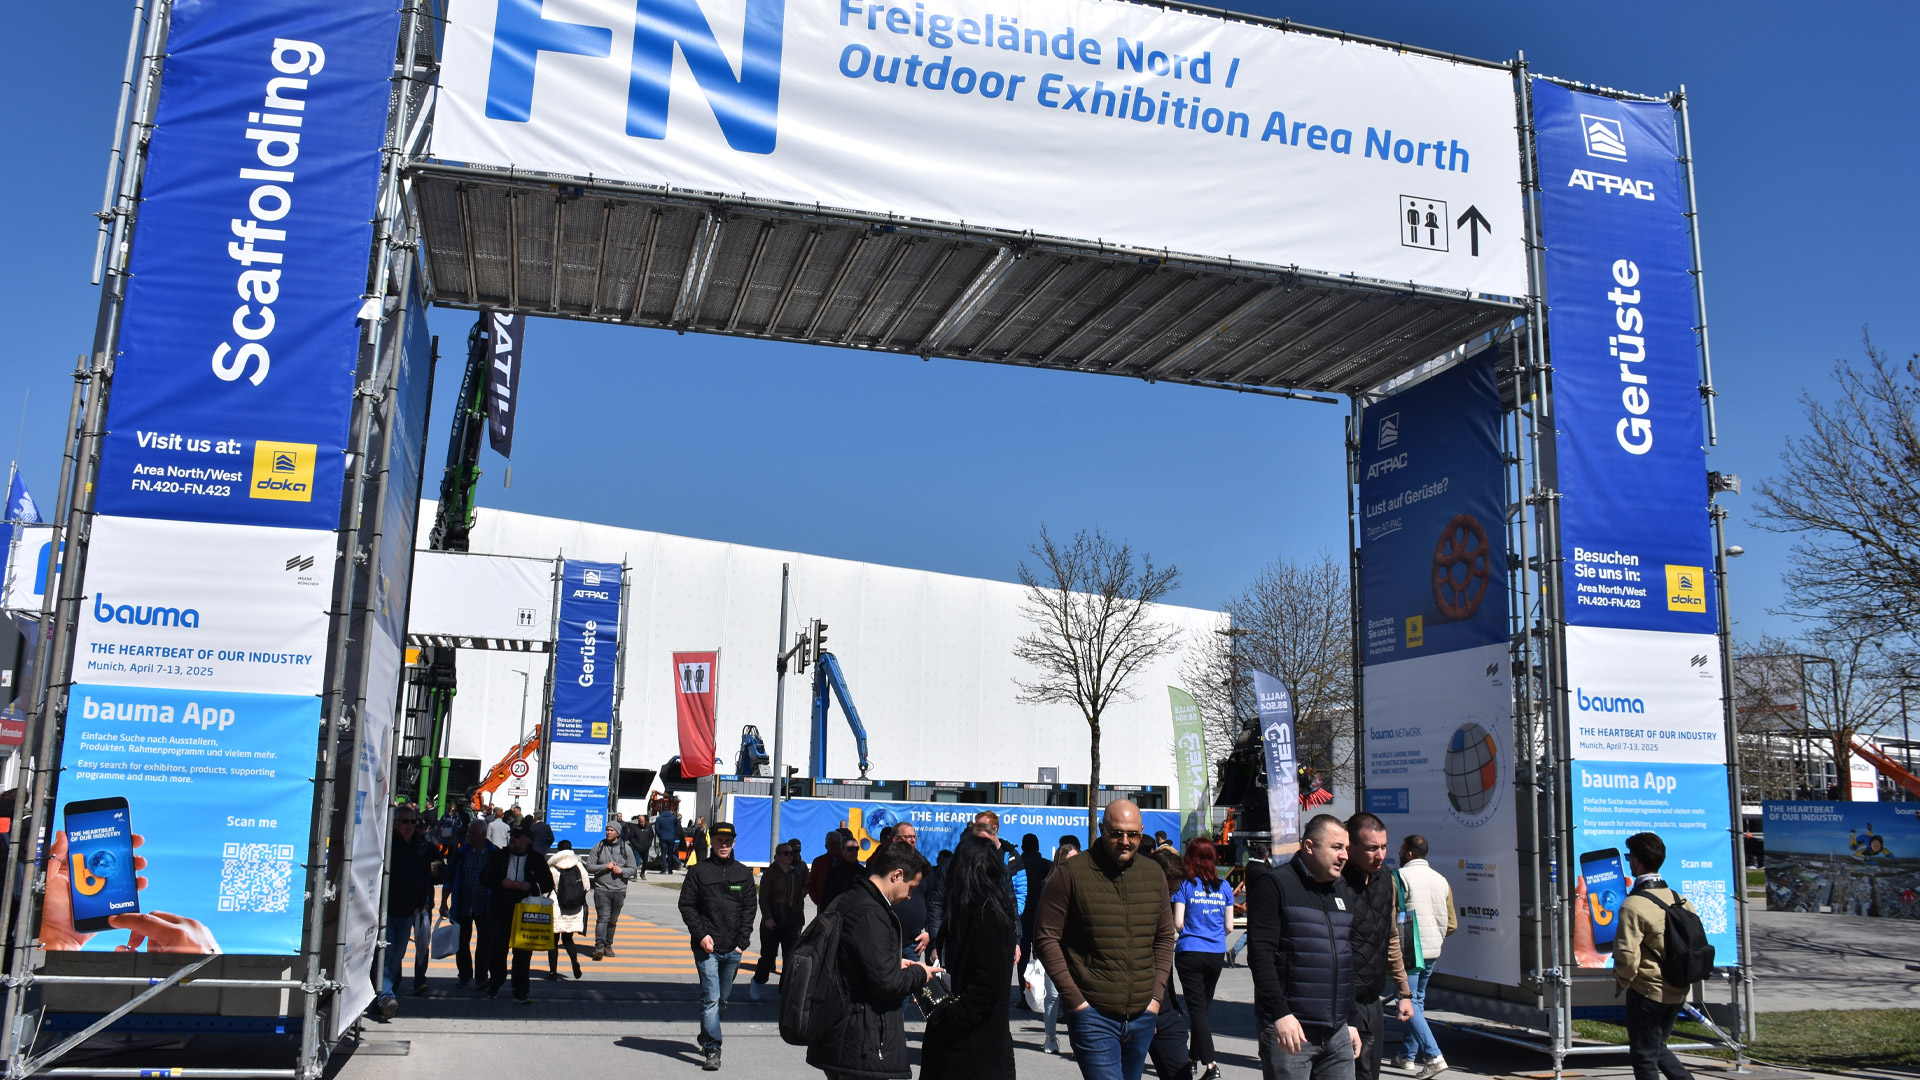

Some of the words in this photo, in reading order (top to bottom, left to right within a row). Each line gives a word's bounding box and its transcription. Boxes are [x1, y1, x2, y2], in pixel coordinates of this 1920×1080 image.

[840, 0, 1101, 64] Freigelände
[1117, 37, 1212, 85] Nord
[1224, 57, 1240, 89] /
[485, 0, 784, 155] FN
[839, 43, 1026, 101] Outdoor
[1037, 73, 1249, 138] Exhibition
[1261, 111, 1352, 155] Area
[1364, 127, 1470, 173] North
[212, 37, 326, 387] Scaffolding
[1608, 258, 1653, 455] Gerüste
[136, 430, 182, 450] Visit
[187, 438, 211, 453] us
[215, 439, 242, 455] at:
[133, 463, 164, 476] Area
[167, 465, 242, 482] North/West
[131, 479, 231, 497] FN.420-FN.423
[256, 477, 307, 492] doka
[1366, 498, 1387, 518] Lust
[1388, 492, 1404, 510] auf
[1404, 477, 1449, 505] Gerüste?
[1574, 547, 1639, 566] Besuchen
[1574, 563, 1596, 578] Sie
[1598, 567, 1623, 580] uns
[1625, 567, 1641, 582] in:
[1577, 583, 1597, 593] Area
[1598, 584, 1647, 597] North/West
[1577, 596, 1641, 609] FN.420-FN.423
[1671, 594, 1702, 605] doka
[94, 592, 200, 628] bauma
[1368, 617, 1394, 629] Besuchen
[90, 642, 116, 654] THE
[119, 644, 194, 659] HEARTBEAT
[197, 649, 214, 660] OF
[217, 650, 245, 661] OUR
[248, 652, 313, 665] INDUSTRY
[578, 620, 597, 687] Gerüste
[87, 660, 127, 673] Munich,
[129, 663, 154, 675] April
[156, 665, 183, 676] 7-13,
[186, 666, 214, 676] 2025
[1577, 687, 1645, 714] bauma
[82, 696, 175, 723] bauma
[181, 702, 236, 731] App
[81, 731, 119, 742] Einfache
[119, 733, 146, 743] Suche
[147, 735, 167, 744] nach
[169, 736, 219, 747] Ausstellern,
[1370, 726, 1394, 740] bauma
[1579, 727, 1596, 736] THE
[1597, 728, 1644, 738] HEARTBEAT
[1647, 729, 1657, 739] OF
[1659, 730, 1676, 739] OUR
[1678, 731, 1717, 741] INDUSTRY
[80, 742, 127, 753] Produkten,
[128, 745, 205, 757] Rahmenprogramm
[206, 749, 223, 757] und
[224, 749, 252, 758] vielem
[253, 751, 278, 759] mehr.
[1579, 741, 1605, 750] Munich,
[1606, 742, 1622, 751] April
[1623, 743, 1640, 751] 7-13,
[1641, 743, 1659, 751] 2025
[77, 759, 98, 770] Easy
[100, 760, 128, 770] search
[130, 761, 142, 770] for
[143, 763, 188, 773] exhibitors,
[189, 765, 228, 775] products,
[230, 766, 276, 778] supporting
[514, 763, 526, 774] 20
[552, 761, 579, 771] bauma
[76, 771, 125, 781] programme
[126, 772, 143, 781] and
[144, 773, 168, 782] much
[169, 774, 193, 783] more.
[1581, 769, 1640, 789] bauma
[1643, 771, 1677, 794] App
[551, 788, 570, 801] FN
[1583, 797, 1607, 805] Einfache
[1614, 806, 1661, 815] Rahmenprogramm
[1769, 805, 1785, 813] THE
[1786, 805, 1835, 814] HEARTBEAT
[1895, 806, 1917, 815] baum
[226, 815, 255, 828] Scan
[258, 818, 278, 828] me
[910, 811, 932, 822] THE
[1003, 814, 1018, 825] OF
[1019, 815, 1043, 825] OUR
[1583, 820, 1597, 828] Easy
[1678, 821, 1707, 829] supporting
[1769, 813, 1779, 821] OF
[1801, 814, 1844, 822] INDUSTRY
[82, 826, 116, 835] HEARTBEAT
[1681, 859, 1700, 868] Scan
[1194, 891, 1223, 899] Deliering
[109, 900, 135, 910] bauma
